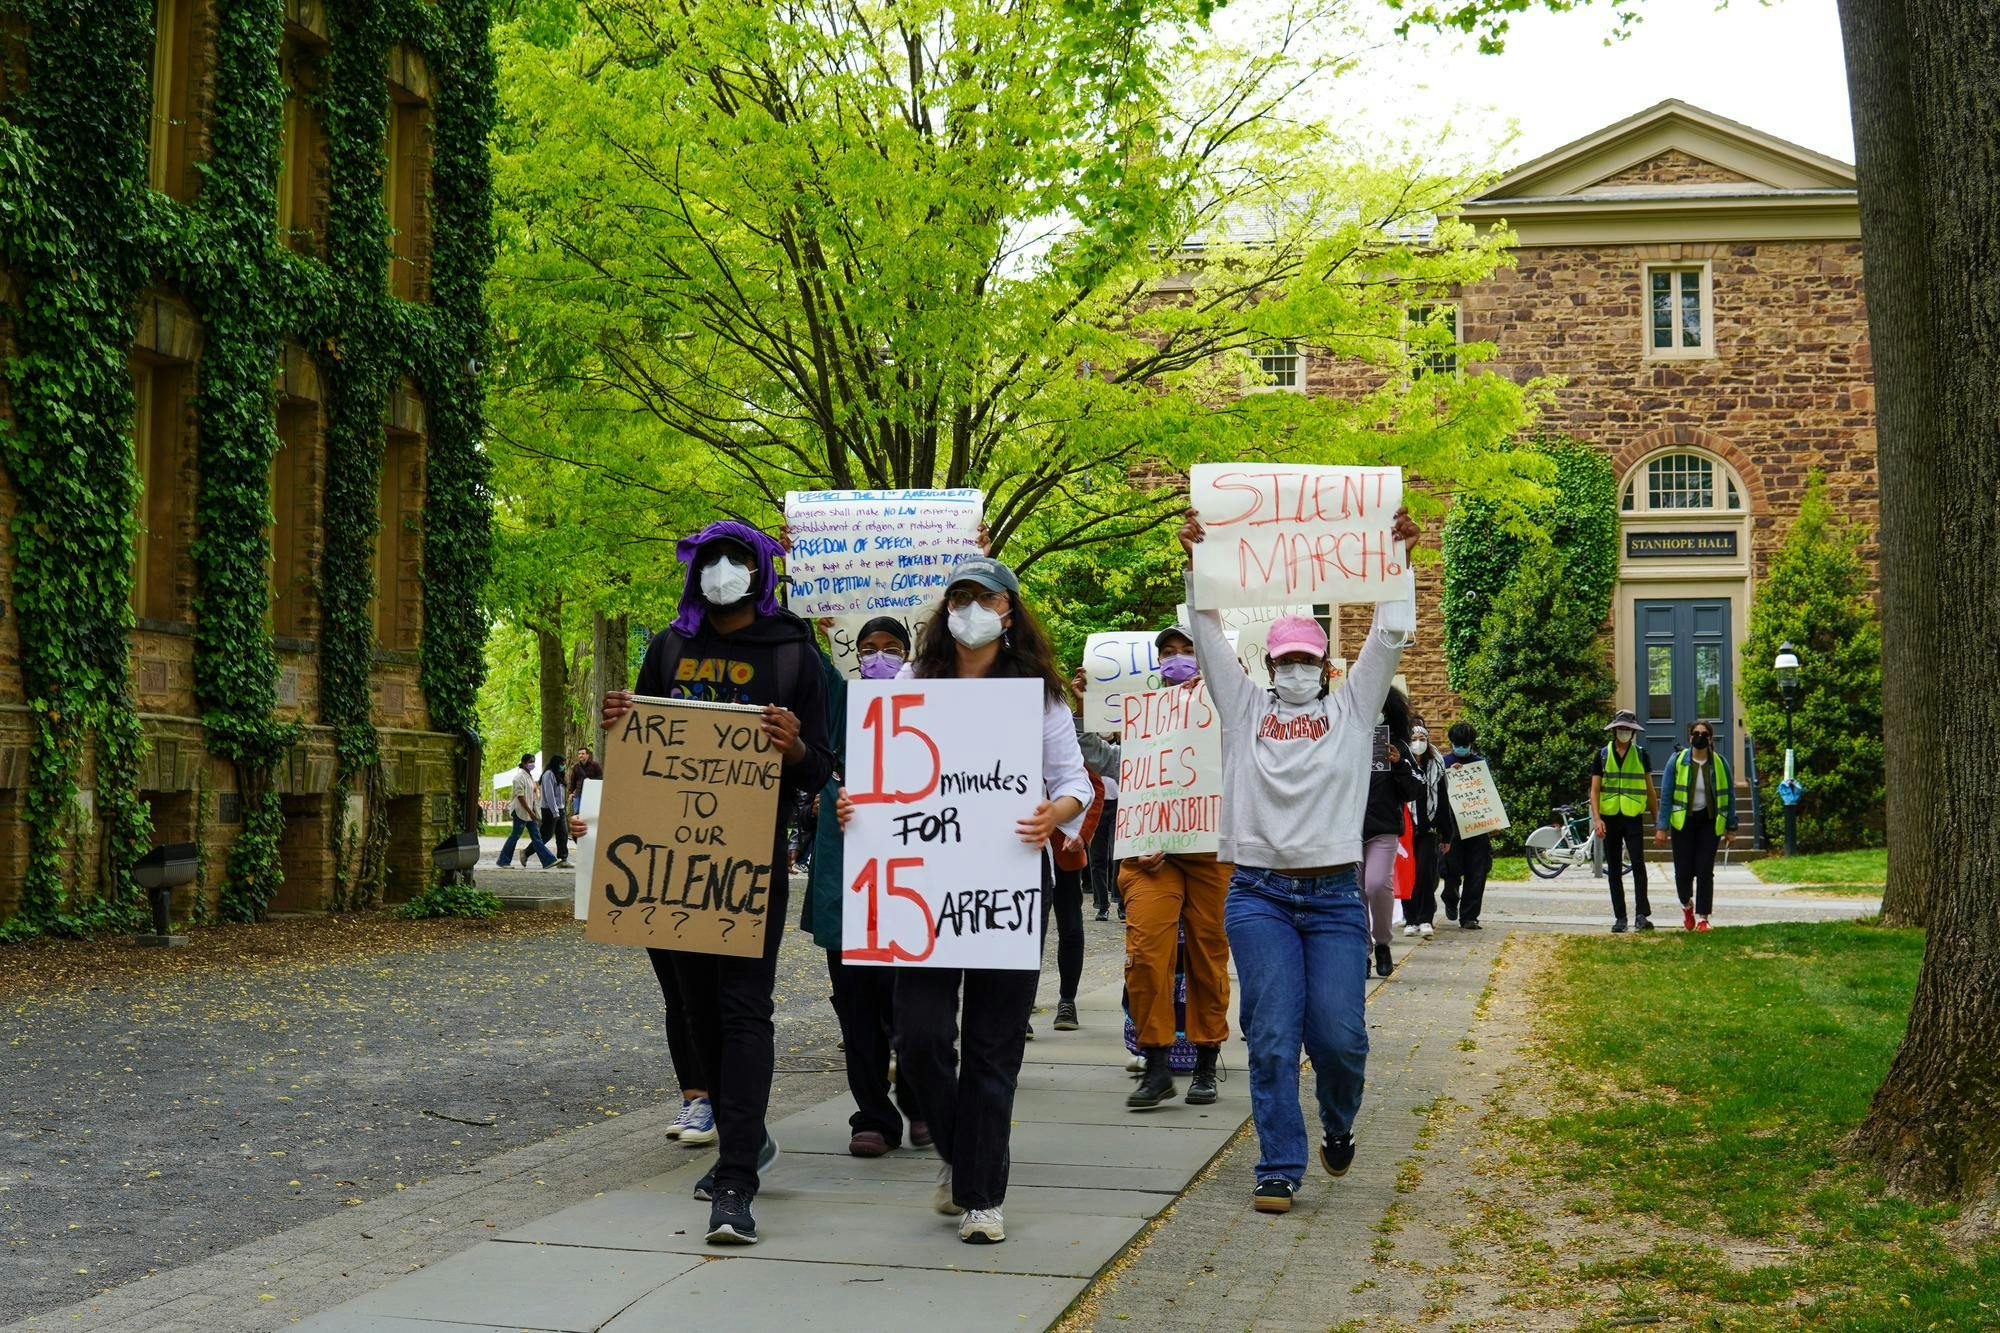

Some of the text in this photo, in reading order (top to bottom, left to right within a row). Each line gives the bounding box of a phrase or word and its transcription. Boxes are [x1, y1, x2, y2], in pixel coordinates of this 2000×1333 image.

[851, 491, 875, 500] THE
[902, 490, 977, 500] AMENDMENT
[1206, 473, 1397, 526] SILENT
[786, 504, 826, 518] Congress
[829, 508, 850, 517] shall
[856, 508, 879, 516] make
[884, 507, 896, 517] NO
[898, 507, 917, 515] LAW
[788, 521, 848, 534] establishment
[852, 521, 861, 531] of
[791, 536, 847, 560] FREEDOM
[853, 537, 868, 553] OF
[946, 537, 960, 545] the
[1631, 538, 1732, 549] STANHOPE HALL
[845, 559, 853, 570] of
[860, 559, 871, 568] the
[875, 558, 894, 568] people
[941, 553, 951, 566] TO
[1239, 528, 1401, 594] MARCH!
[791, 580, 813, 597] AND
[814, 577, 829, 594] TO
[832, 576, 871, 594] PETITION
[891, 573, 951, 591] GOVERNMEN
[849, 599, 861, 610] of
[621, 711, 771, 753] ARE YOU
[848, 693, 1028, 804] 15 minutes
[642, 751, 782, 790] LISTENING
[1120, 746, 1197, 792] RULES
[1446, 768, 1470, 780] THIS
[1459, 775, 1474, 783] THE
[1455, 779, 1483, 790] TIME
[677, 790, 718, 819] TO
[1451, 791, 1473, 801] THIS
[1458, 809, 1481, 818] THIS
[675, 825, 727, 846] OUR
[892, 807, 961, 846] FOR
[605, 834, 773, 916] SILENCE
[842, 857, 1041, 963] 15 ARREST
